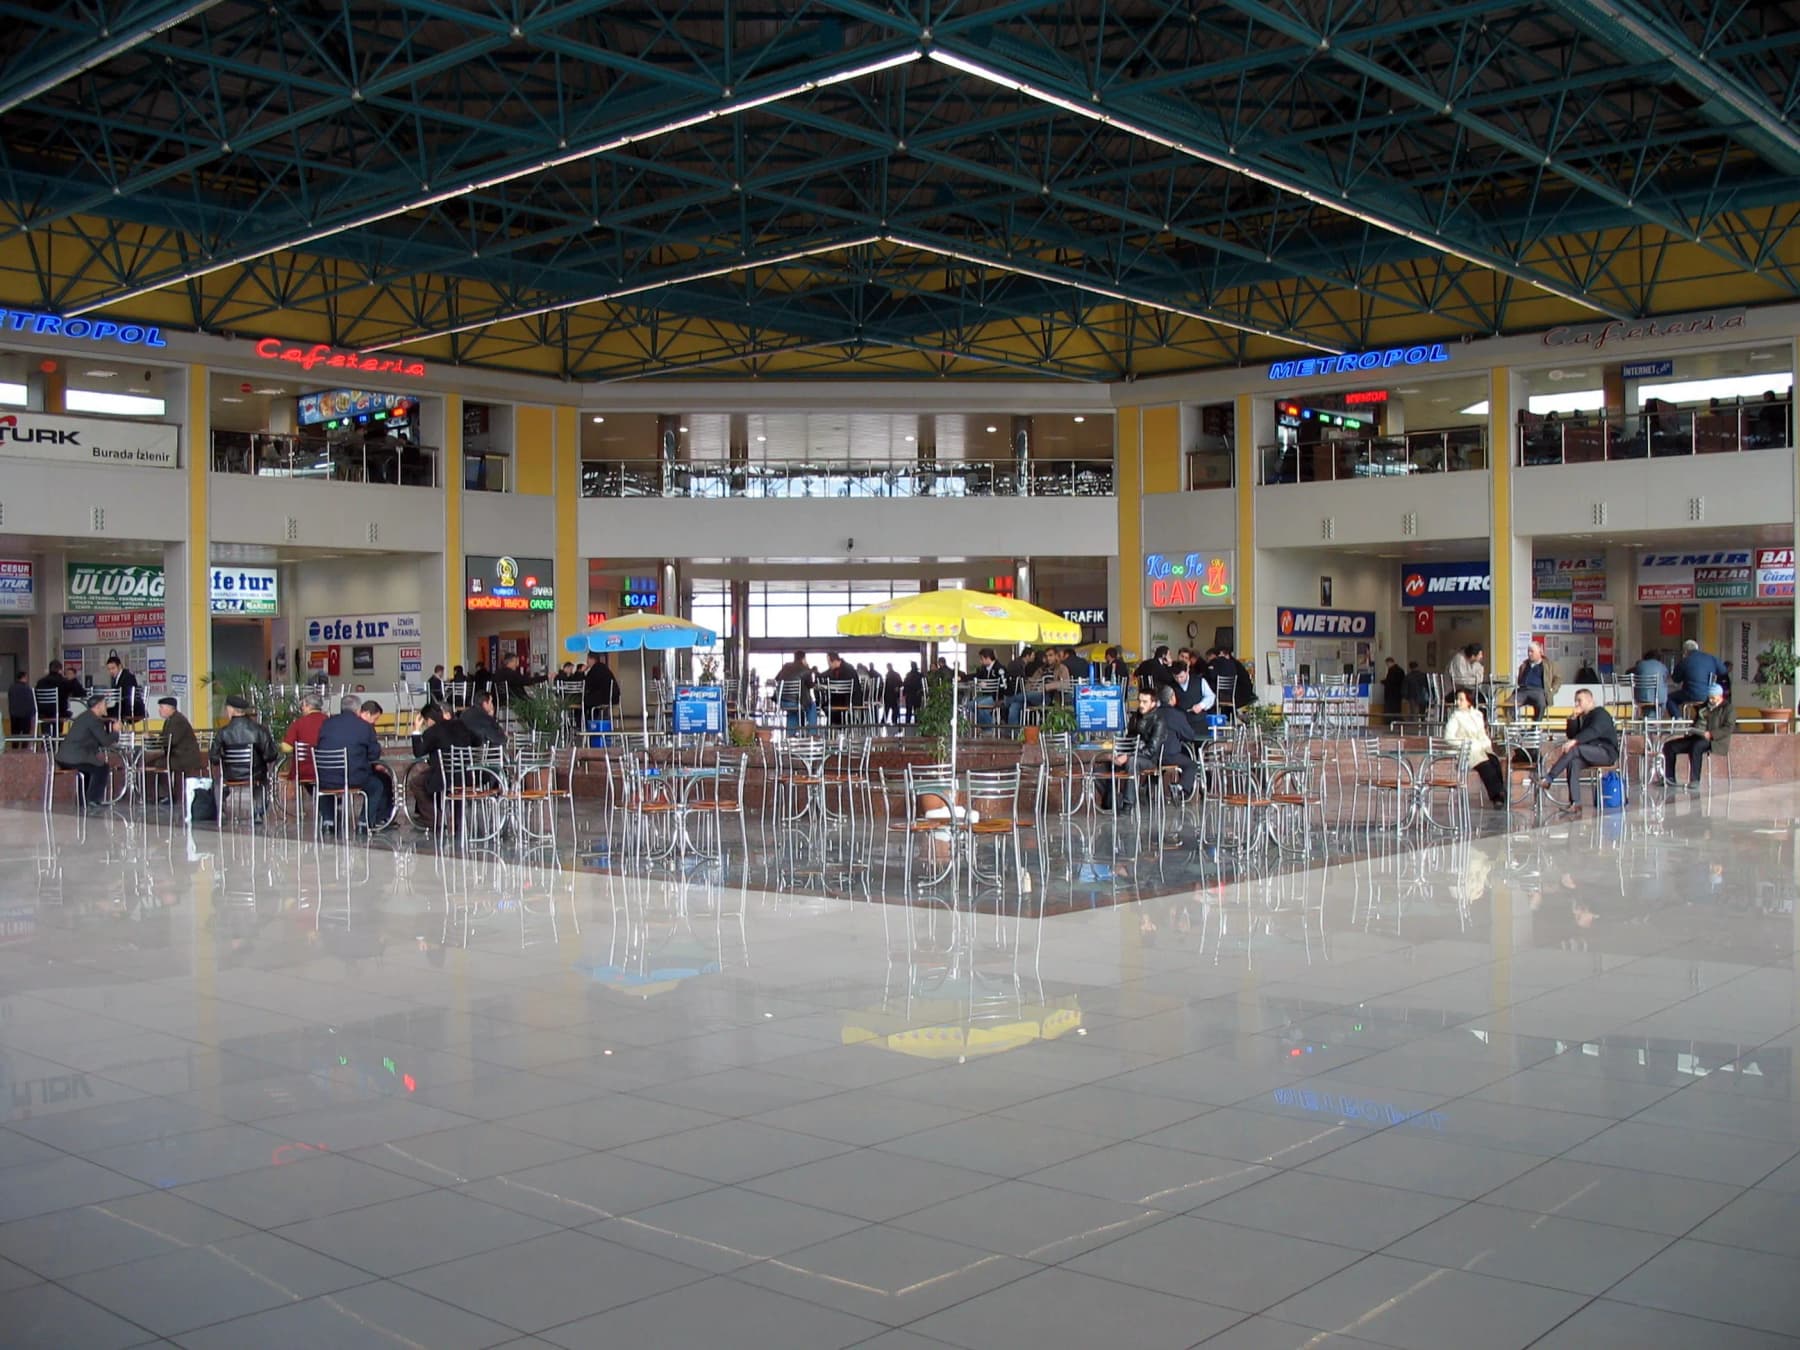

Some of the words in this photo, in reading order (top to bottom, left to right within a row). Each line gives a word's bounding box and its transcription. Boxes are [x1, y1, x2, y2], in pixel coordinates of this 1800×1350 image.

[1269, 344, 1449, 380] METROPOL
[92, 447, 134, 460] Burada
[136, 448, 170, 462] İzlenir
[239, 573, 274, 591] tur
[1697, 568, 1750, 579] HAZAR
[323, 619, 352, 640] efe
[356, 620, 389, 639] tur
[1293, 613, 1367, 633] METRO
[690, 691, 717, 699] PEPSI
